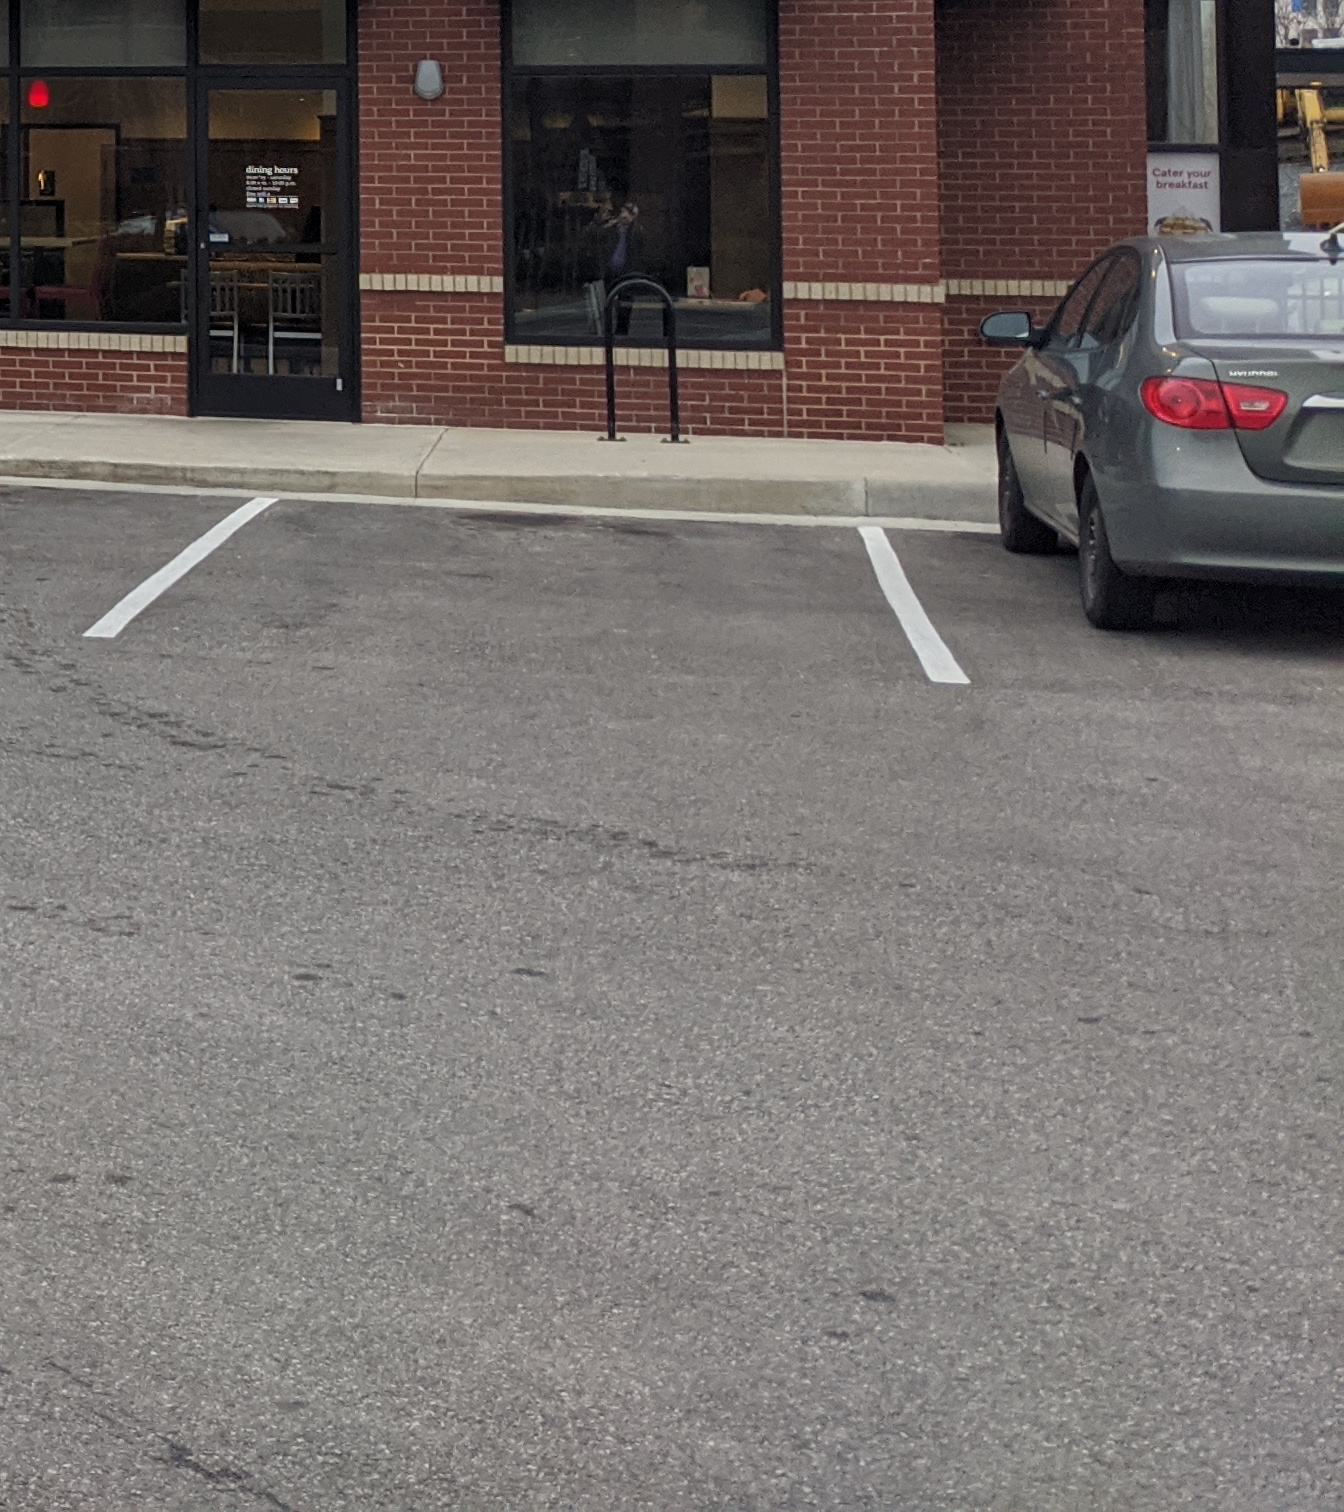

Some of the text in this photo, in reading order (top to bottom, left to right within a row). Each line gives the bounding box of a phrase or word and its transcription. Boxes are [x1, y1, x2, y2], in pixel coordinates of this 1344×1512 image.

[245, 165, 299, 176] dining hours
[1152, 168, 1212, 179] Cater your
[1156, 180, 1210, 190] breakfast
